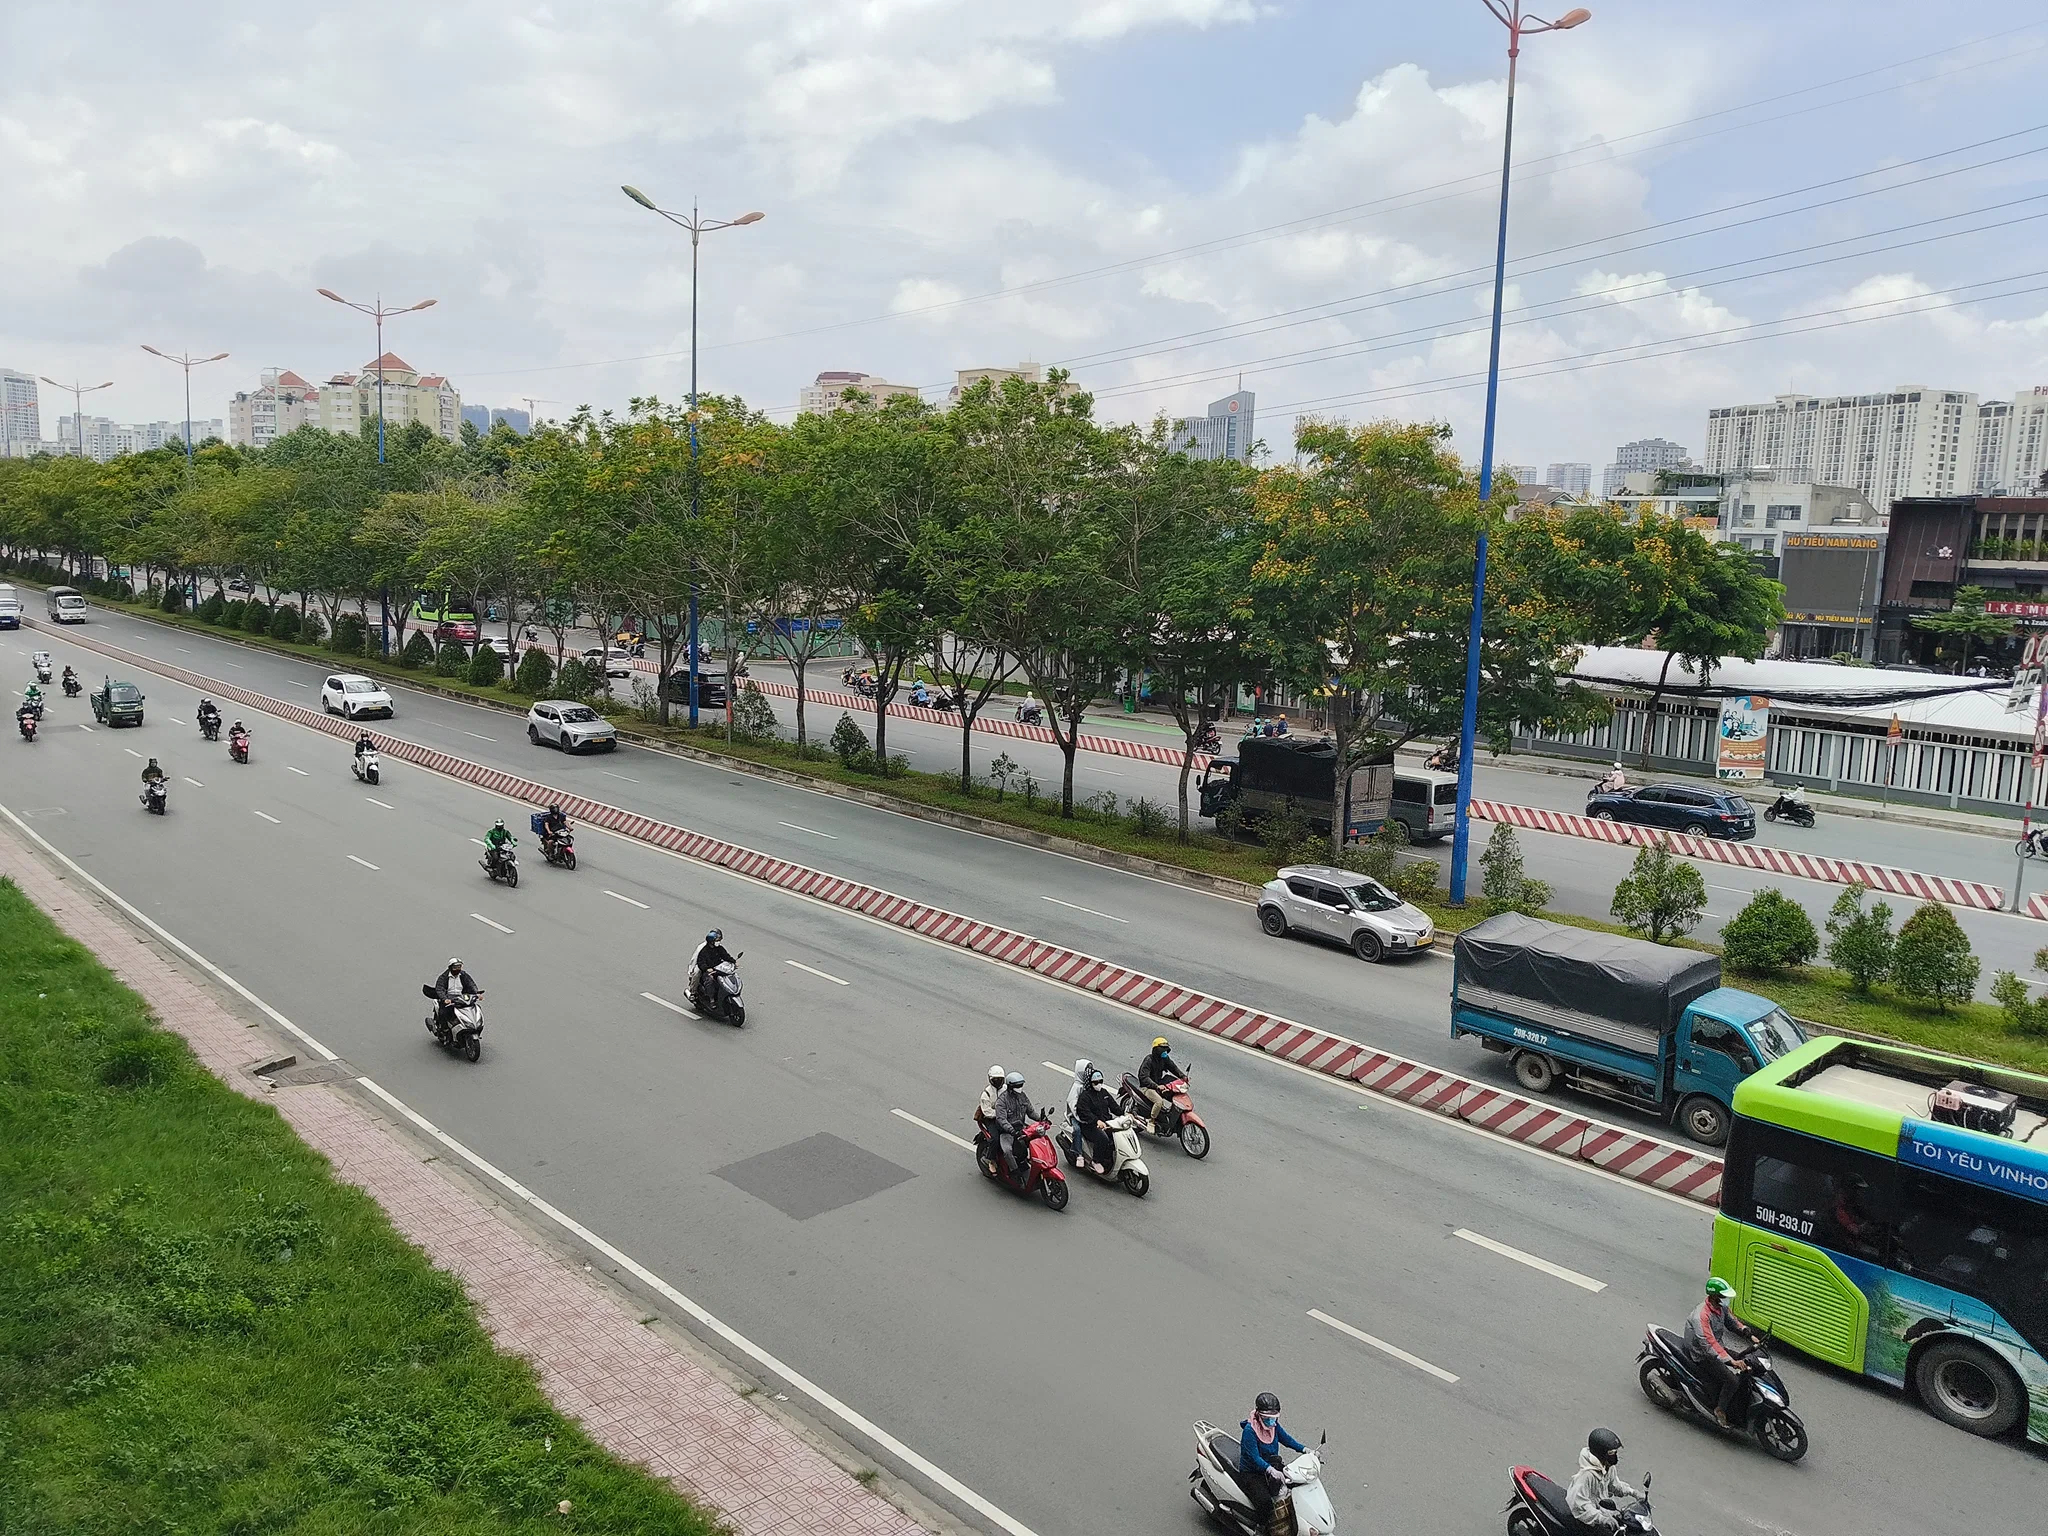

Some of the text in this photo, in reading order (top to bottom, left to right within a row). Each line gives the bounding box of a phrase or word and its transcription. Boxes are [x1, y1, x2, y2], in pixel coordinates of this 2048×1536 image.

[1826, 537, 1848, 548] NAM
[1850, 538, 1878, 549] VANG
[1913, 1140, 1942, 1160] TÔI
[1946, 1150, 1983, 1171] YÊU
[1755, 1205, 1814, 1237] 50H-293.07
